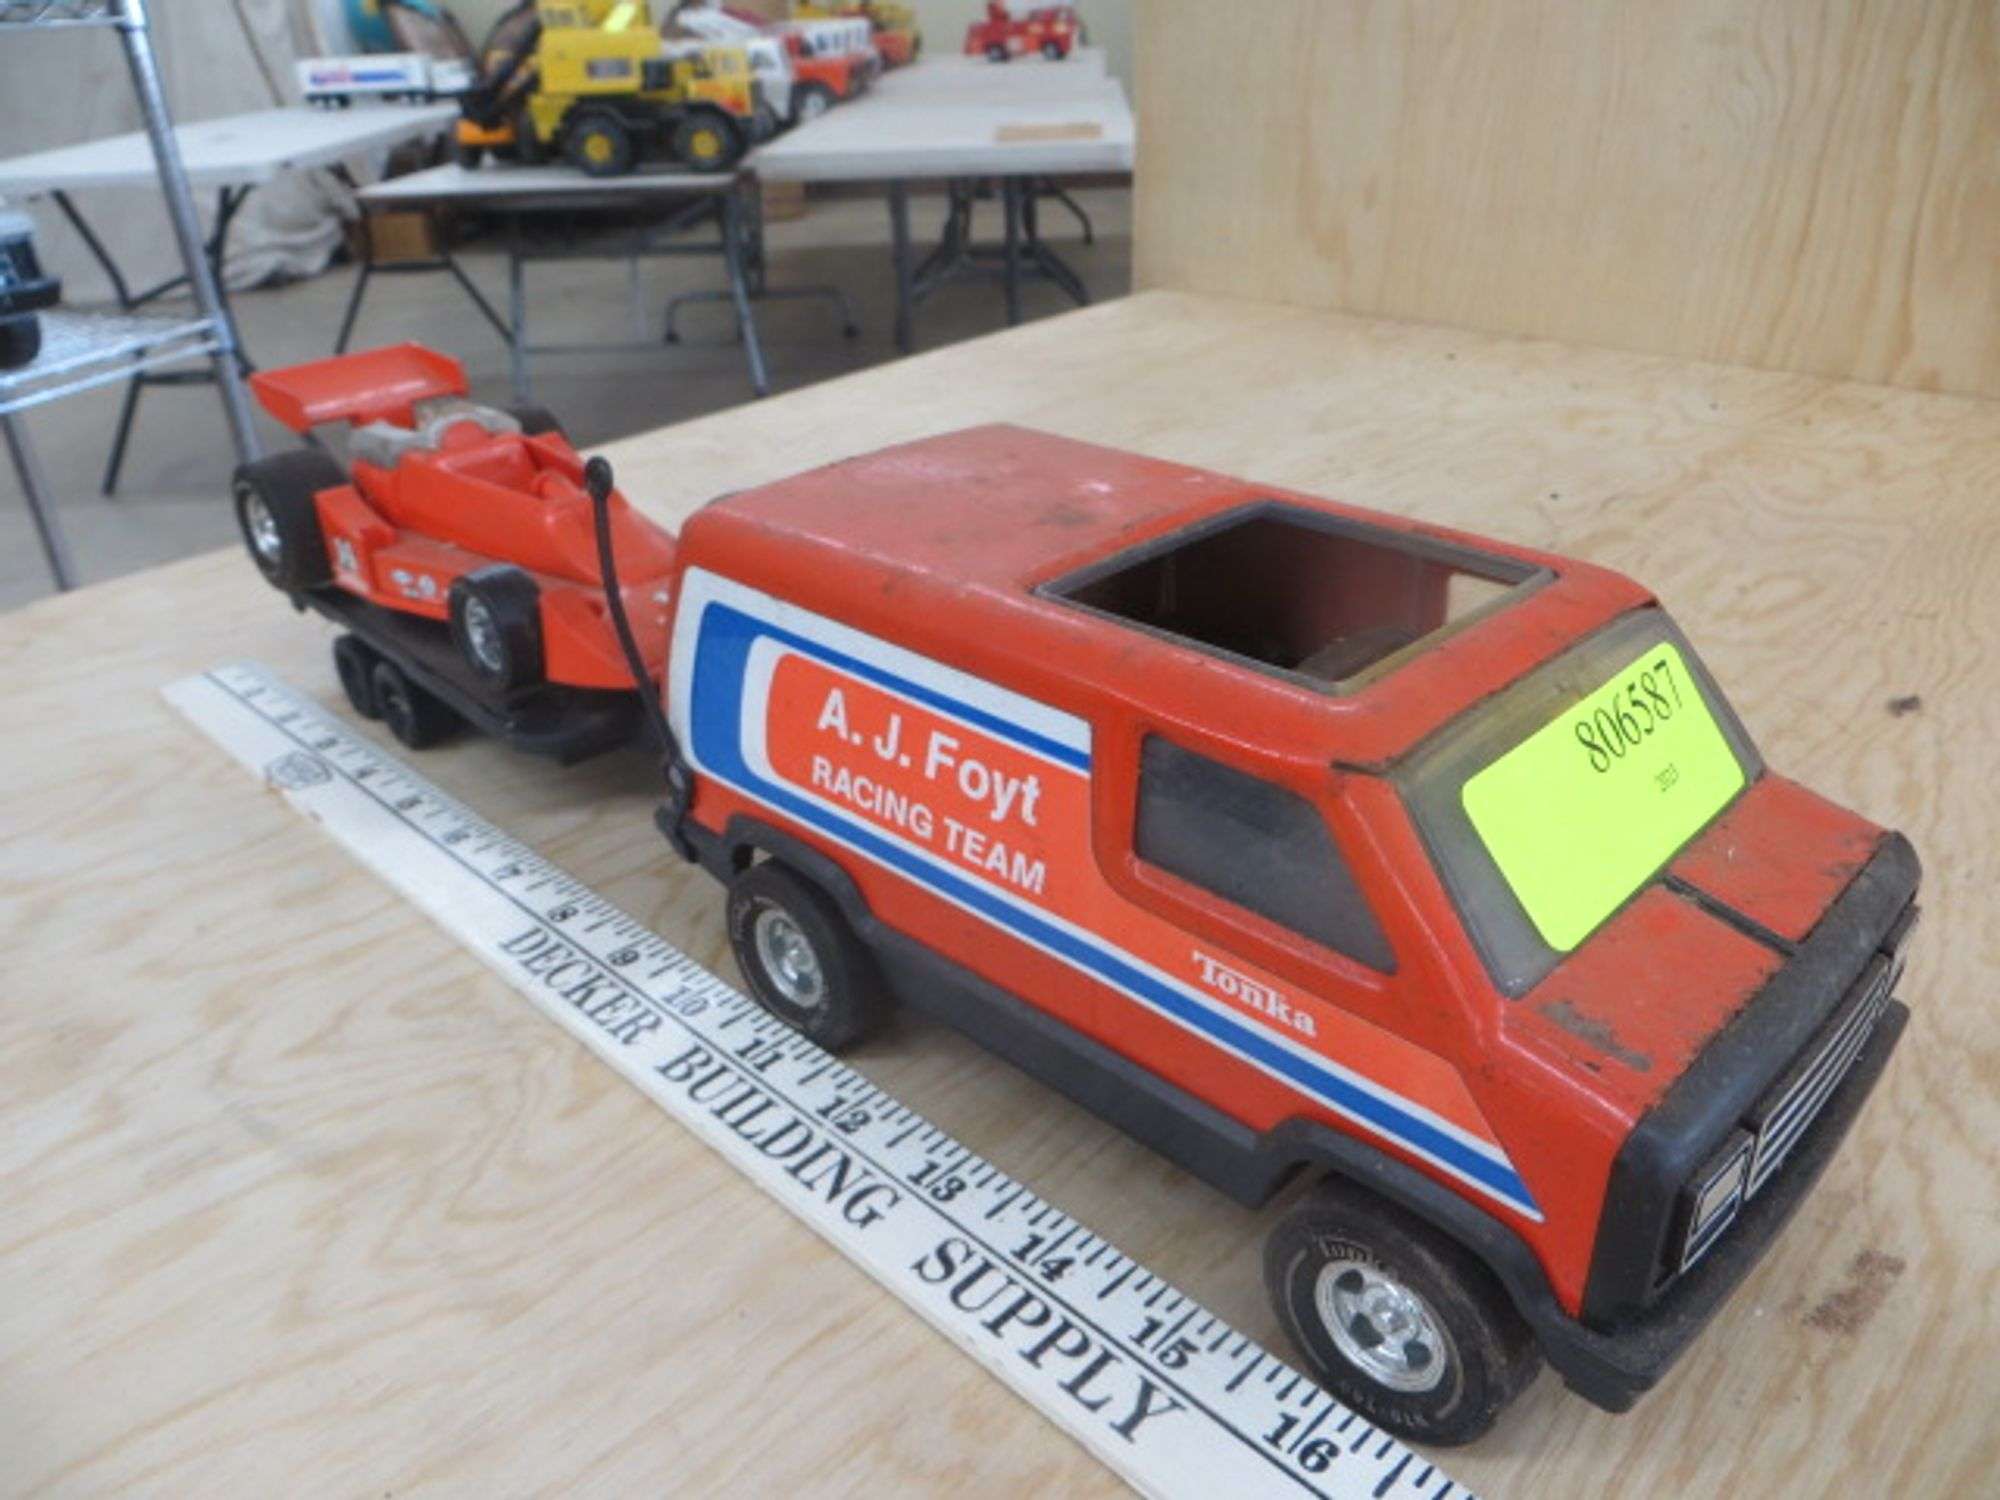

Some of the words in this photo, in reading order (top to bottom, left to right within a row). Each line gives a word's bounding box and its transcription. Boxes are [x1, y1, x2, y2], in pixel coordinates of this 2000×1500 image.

[816, 687, 863, 745] A.
[873, 713, 911, 768] J.
[924, 730, 1040, 827] Foyt
[1573, 659, 1683, 773] 806587
[811, 755, 933, 839] RACING
[943, 817, 1045, 894] TEAM
[1191, 950, 1317, 1038] Tonka
[502, 926, 663, 1046] DECKER
[653, 1044, 902, 1229] BUILDING
[910, 1236, 1187, 1444] SUPPLY
[546, 904, 580, 923] 8
[606, 948, 641, 967] 9
[661, 986, 710, 1017] 10
[736, 1038, 785, 1072] 11
[817, 1096, 871, 1133] 12
[906, 1160, 968, 1202] 13
[1009, 1233, 1075, 1284] 14
[1128, 1317, 1202, 1370] 15
[1262, 1412, 1340, 1474] 16
